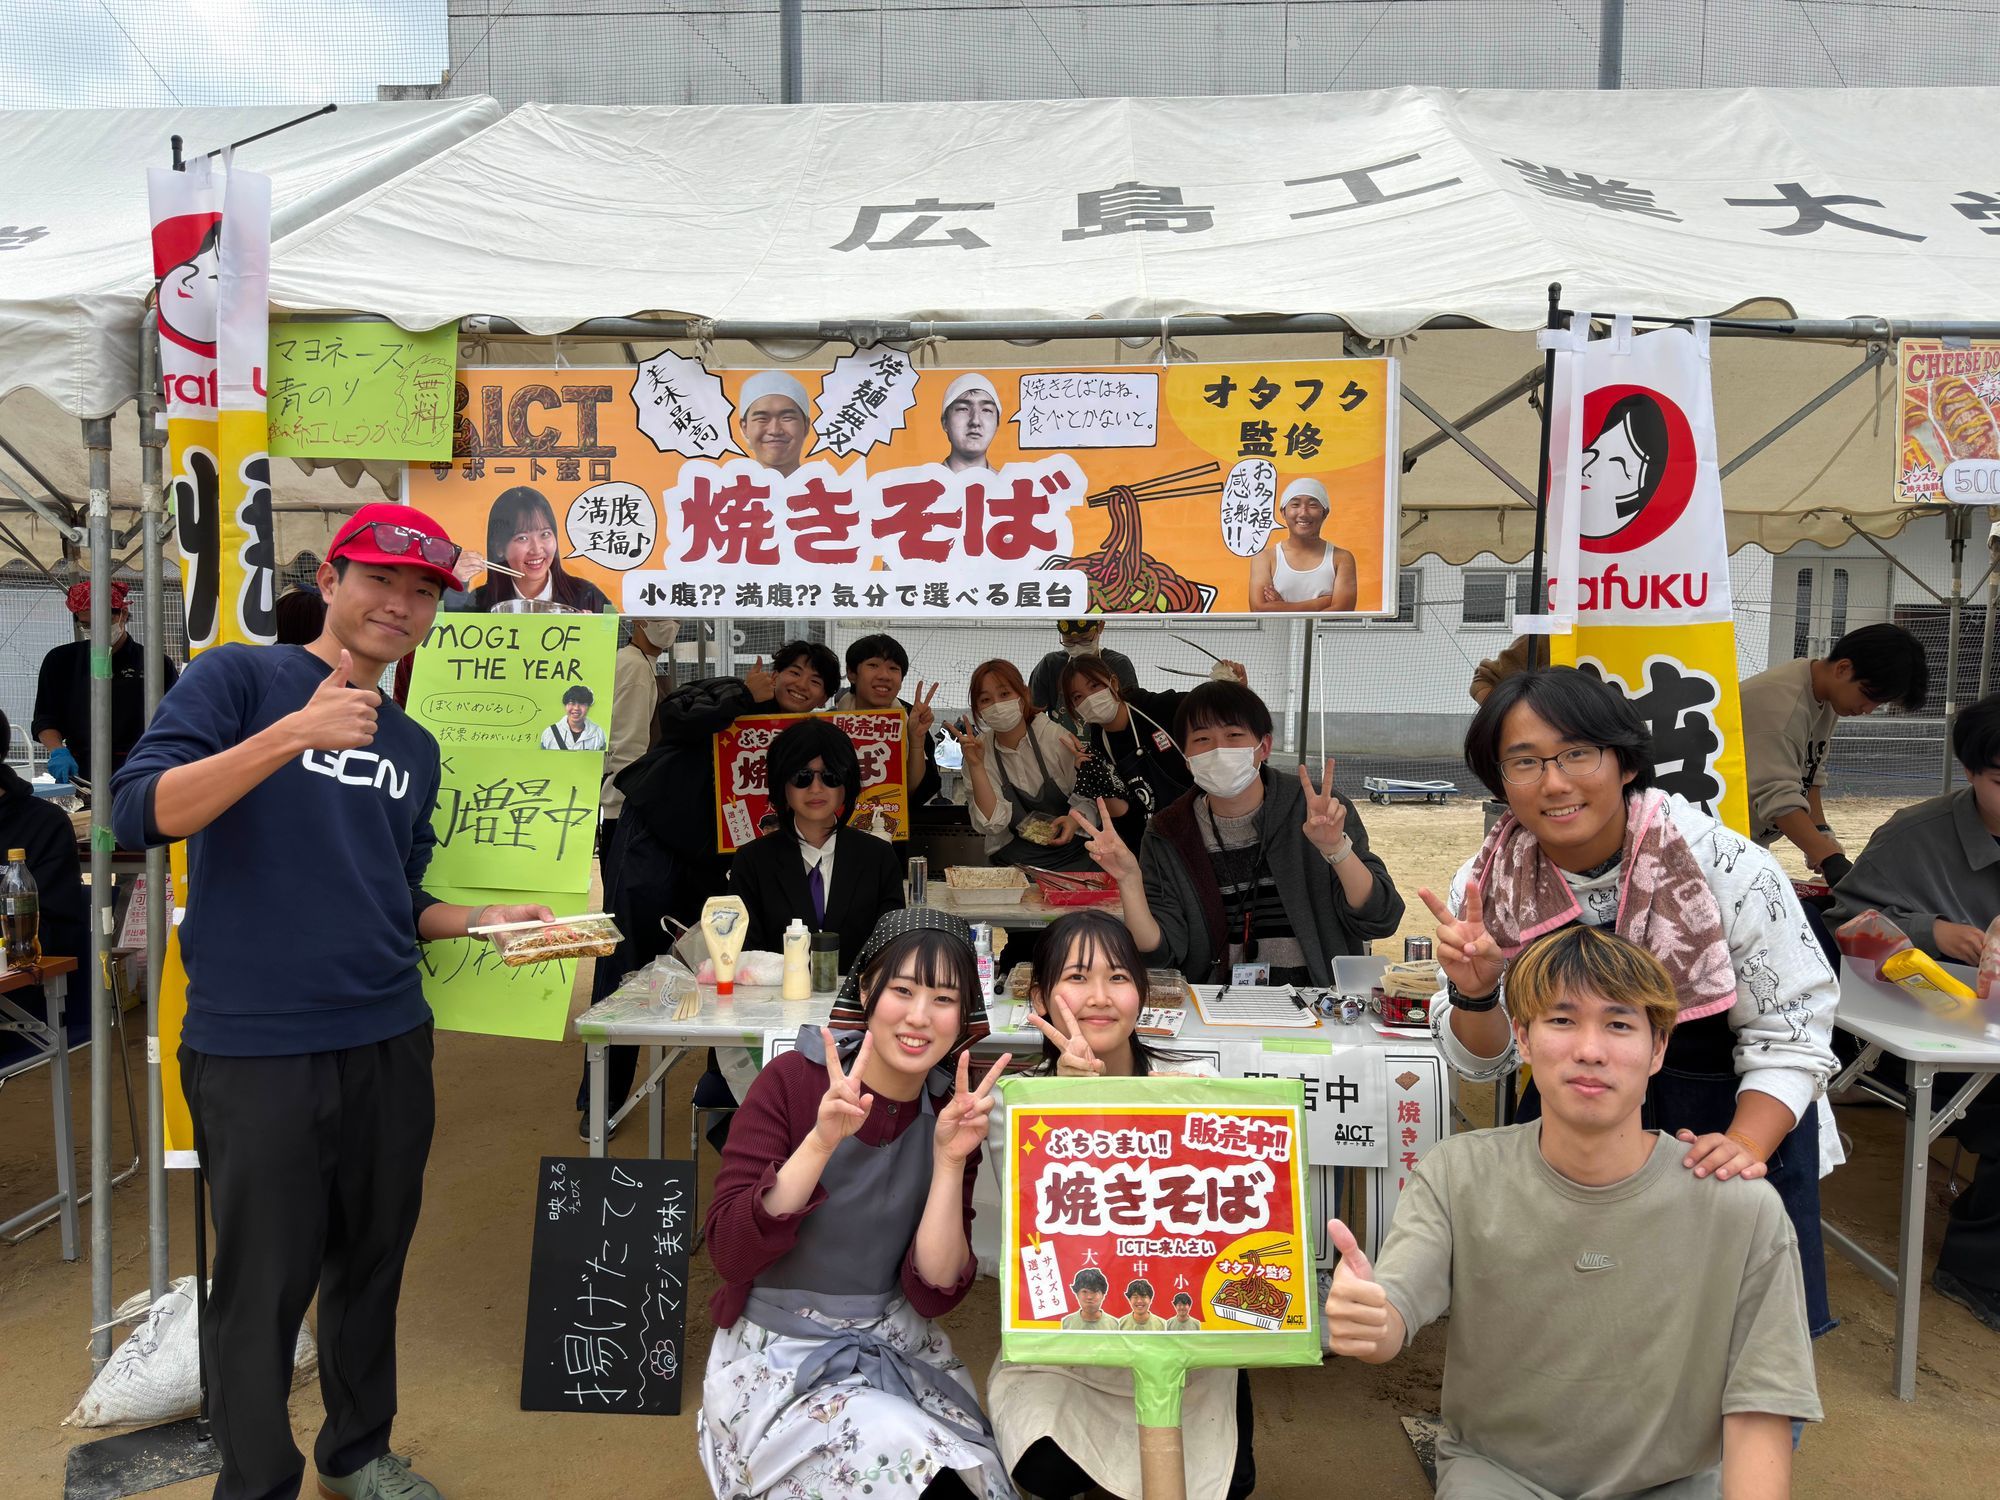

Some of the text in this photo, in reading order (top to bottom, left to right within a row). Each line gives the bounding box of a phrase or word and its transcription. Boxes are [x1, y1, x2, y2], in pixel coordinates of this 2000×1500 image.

[276, 337, 413, 374] マヨネーズ
[1907, 351, 1981, 383] CHEESE
[272, 377, 360, 416] 青のり
[405, 370, 446, 435] 無料
[646, 364, 718, 451] 美味最高
[1203, 375, 1369, 411] オタフク
[1237, 420, 1324, 459] 監修
[431, 459, 612, 481] サポート窓口
[1904, 470, 1939, 483] インスタ
[578, 493, 643, 527] 満腹
[680, 470, 1071, 566] 焼きそば
[831, 581, 1073, 608] 気分で選べる屋台
[422, 624, 581, 651] MOGI OF
[447, 658, 583, 682] THE YEAR
[1345, 1124, 1374, 1141] ICT
[1044, 1170, 1266, 1226] 焼きそば
[1082, 1248, 1099, 1265] 大
[1119, 1240, 1214, 1256] ICTに来んさい
[1581, 1250, 1609, 1267] NIKE
[1042, 1256, 1060, 1306] サイズも
[1133, 1260, 1149, 1277] 中
[1173, 1274, 1189, 1289] 小
[1218, 1260, 1291, 1281] オタフク監修
[1028, 1259, 1045, 1309] 選べるよ
